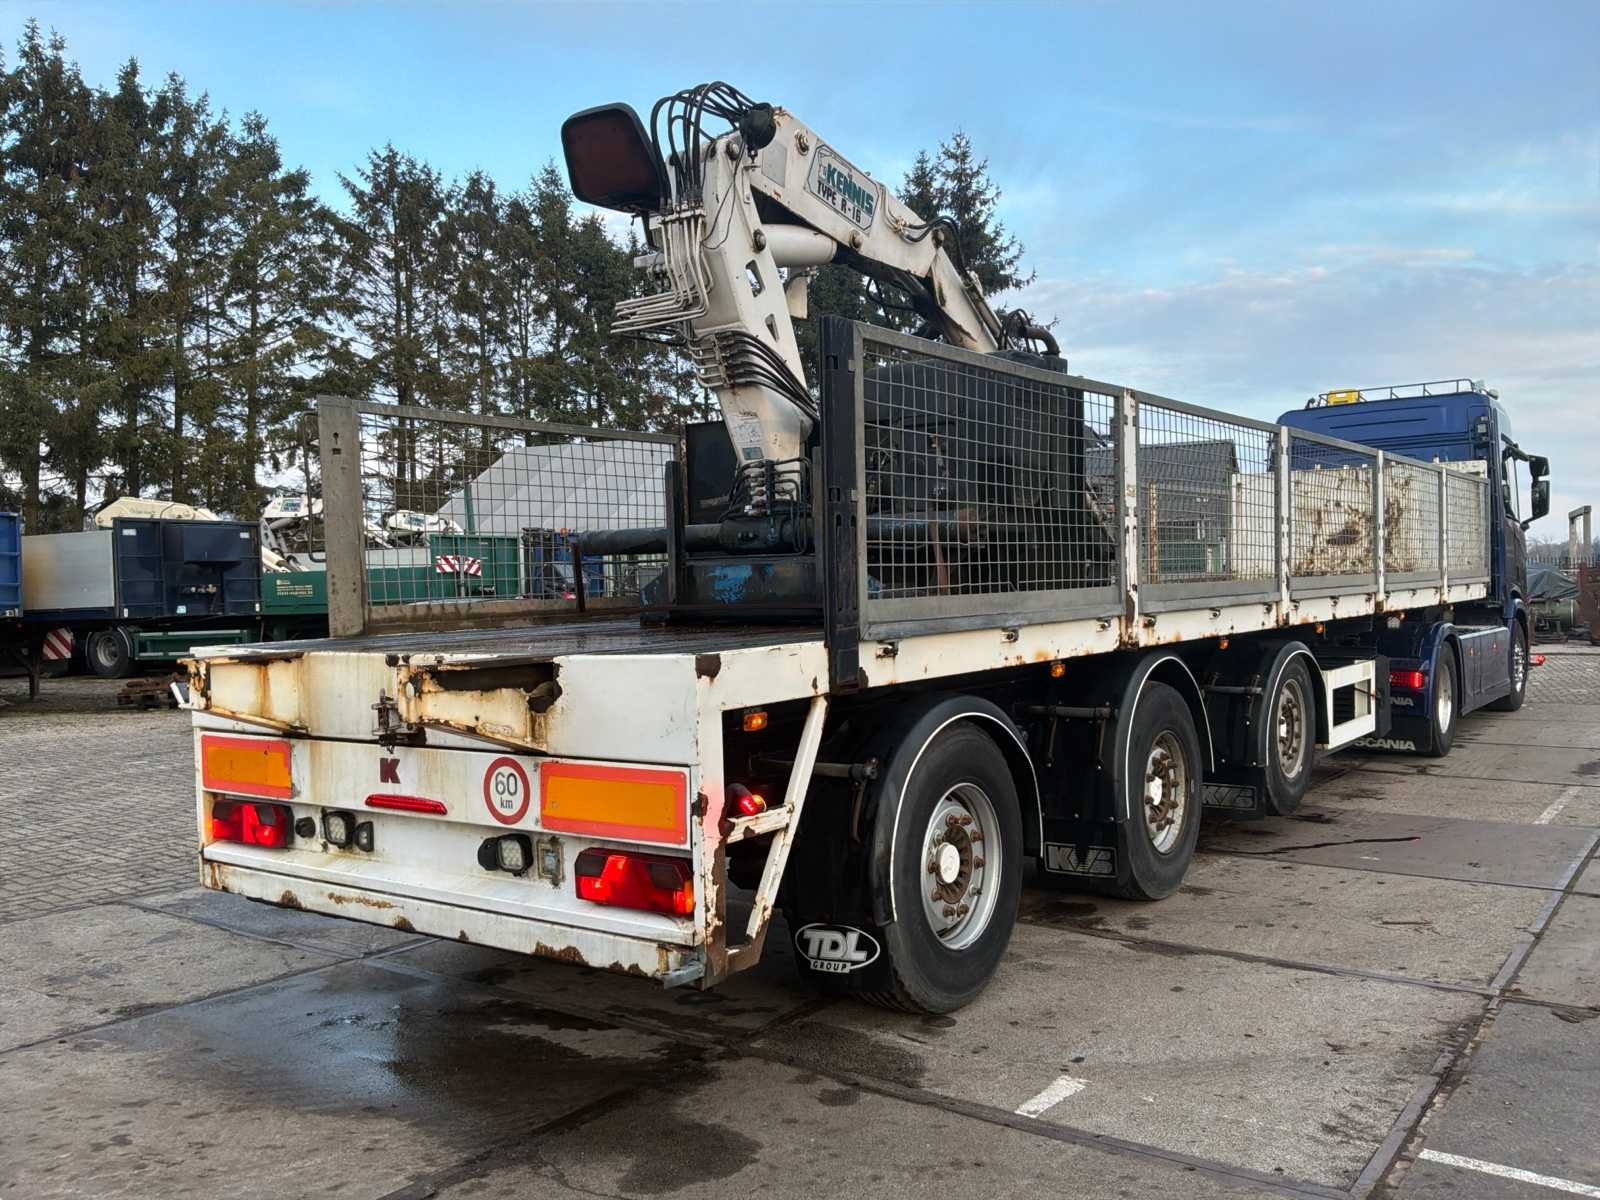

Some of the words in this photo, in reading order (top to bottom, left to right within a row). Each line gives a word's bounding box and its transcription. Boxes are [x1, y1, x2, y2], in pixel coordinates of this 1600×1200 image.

[817, 181, 837, 206] TYPE
[841, 199, 862, 224] R-16
[826, 163, 874, 216] KENNIS
[380, 758, 401, 784] K
[495, 772, 517, 796] 60
[500, 797, 513, 809] km
[803, 929, 867, 961] TDL
[812, 961, 847, 972] GROUP
